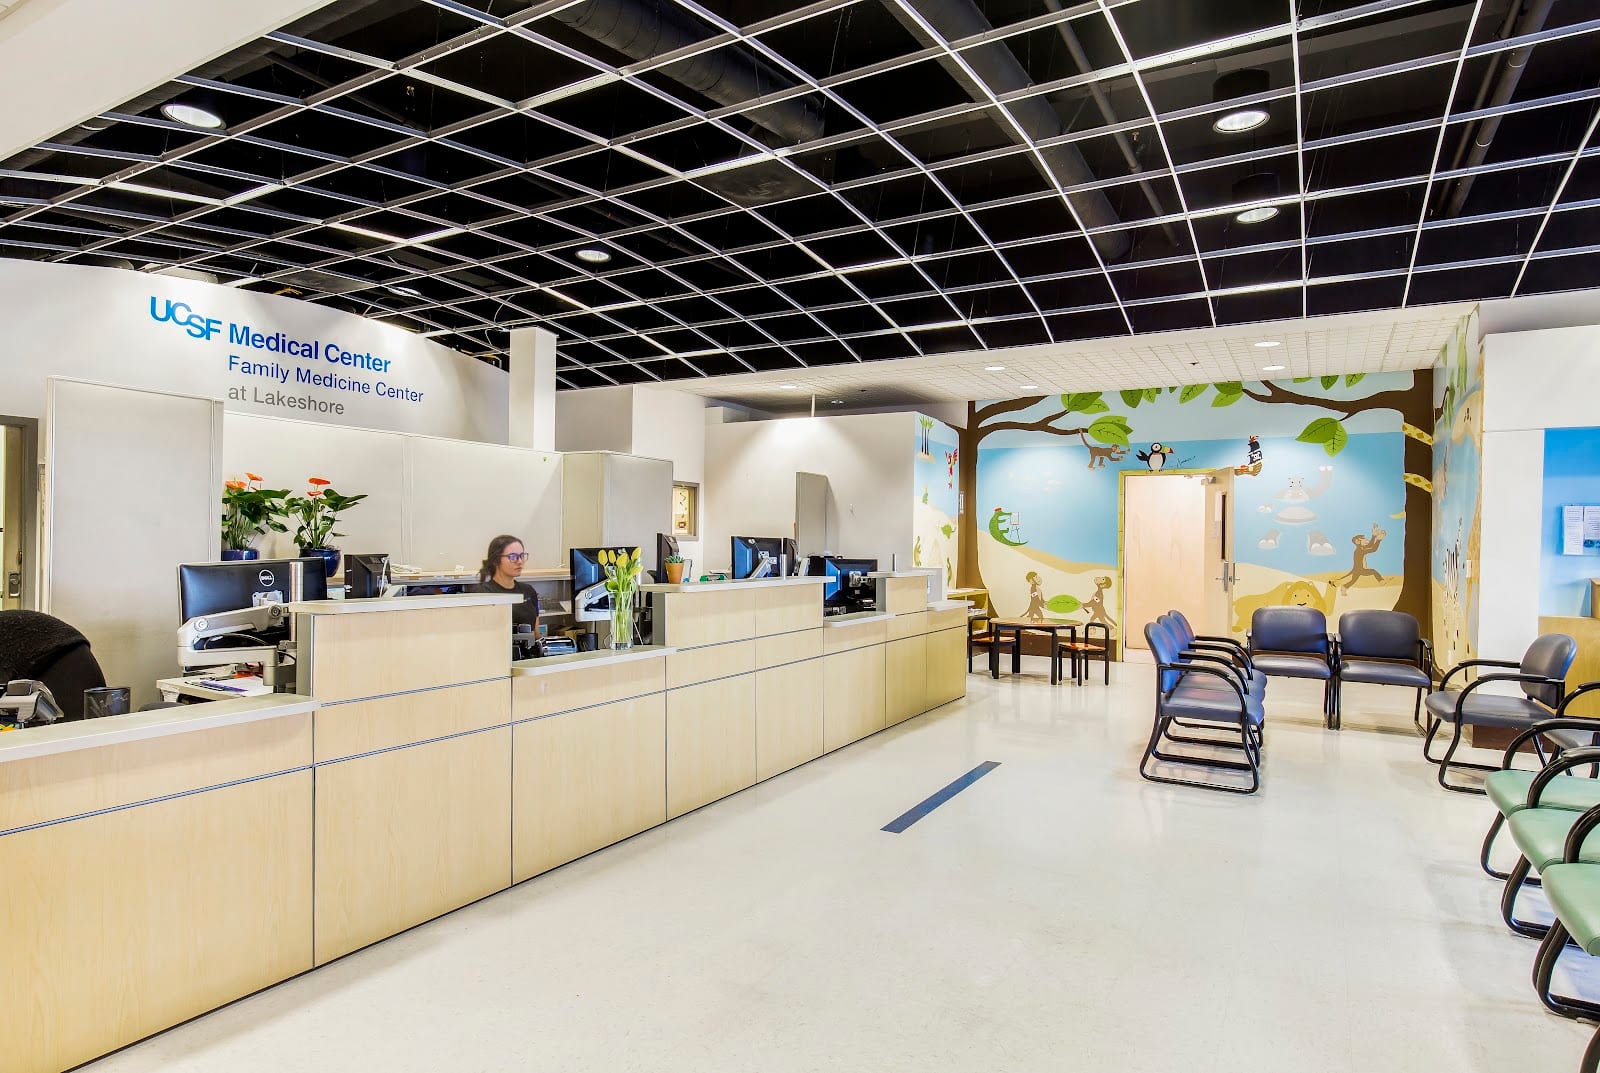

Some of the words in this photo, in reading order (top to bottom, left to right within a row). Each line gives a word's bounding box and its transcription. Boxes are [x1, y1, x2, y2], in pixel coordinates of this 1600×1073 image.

[150, 296, 222, 340] UCSF
[229, 322, 319, 360] Medical
[324, 344, 391, 373] Center
[228, 354, 290, 383] Family
[296, 367, 371, 394] Medicine
[375, 382, 424, 402] Center
[228, 385, 247, 401] at
[254, 387, 345, 415] Lakeshore
